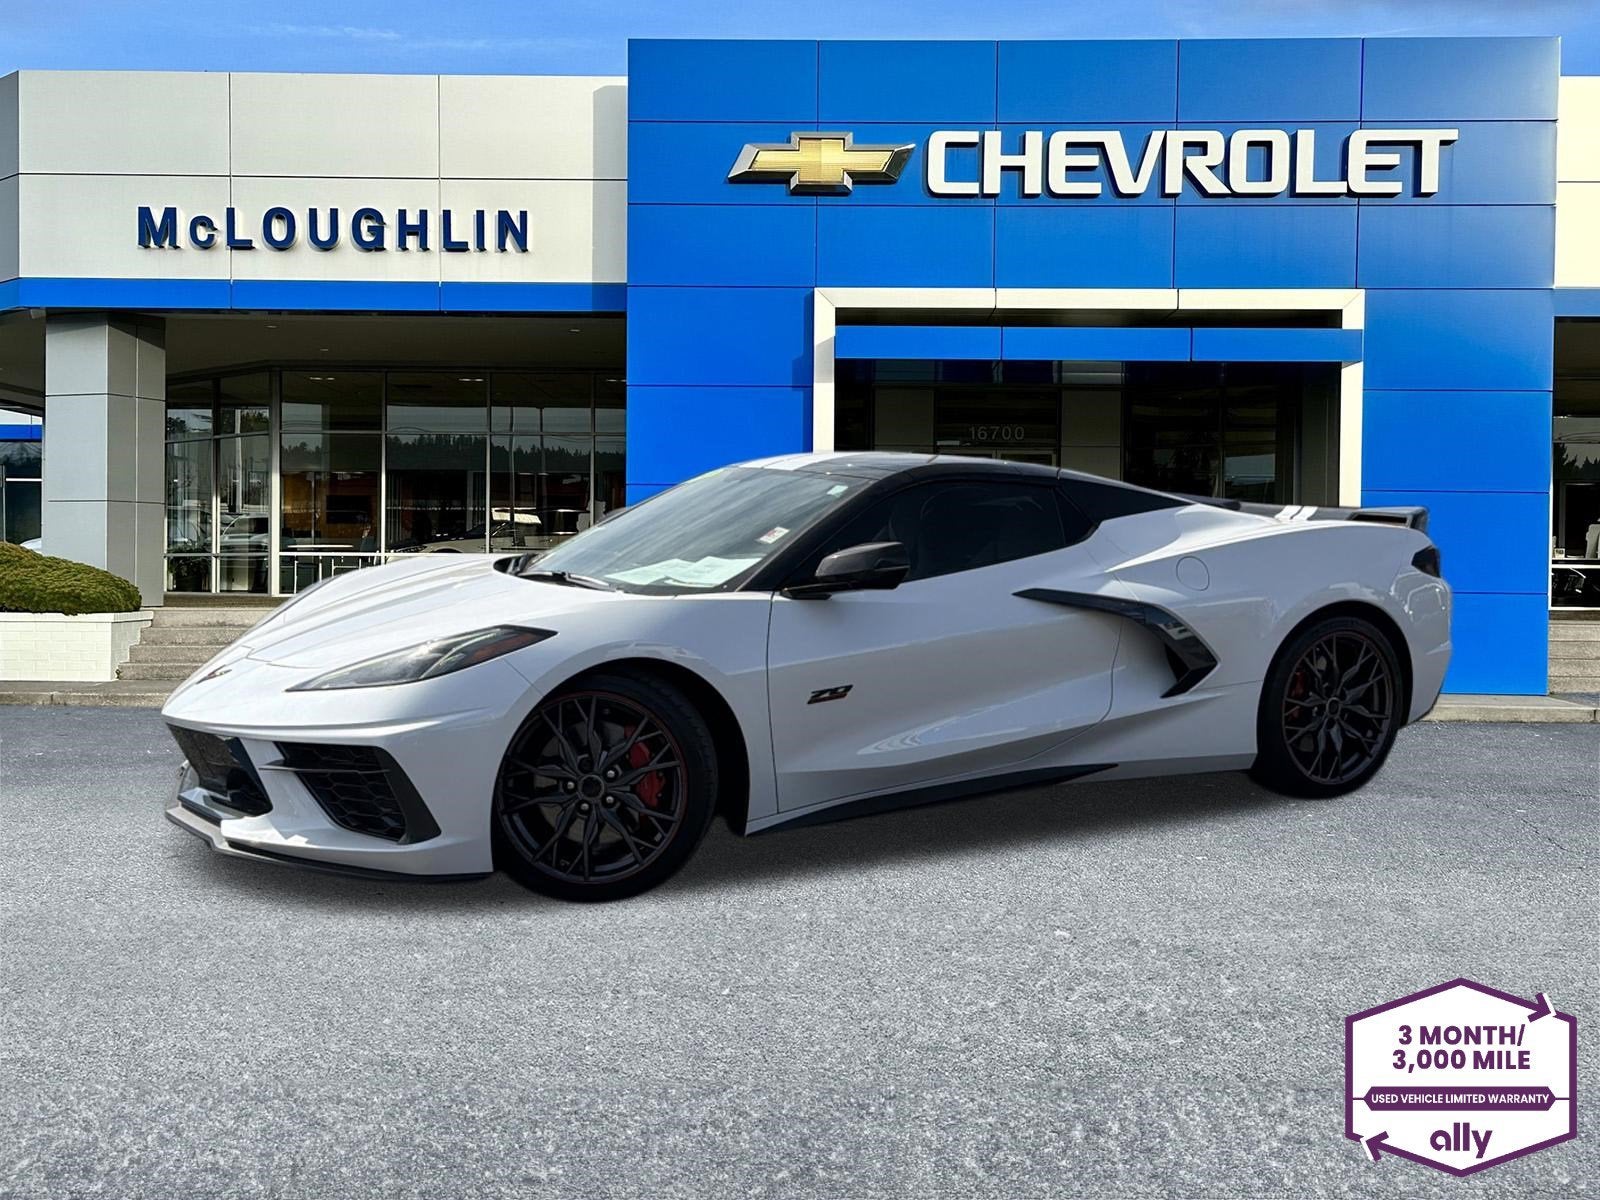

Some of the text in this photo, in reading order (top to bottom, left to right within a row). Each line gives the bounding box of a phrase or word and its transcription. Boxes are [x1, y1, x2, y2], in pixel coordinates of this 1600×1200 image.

[927, 128, 1459, 196] CHEVROLET
[137, 205, 529, 253] McLOUGHLIN
[970, 425, 1025, 441] 16700
